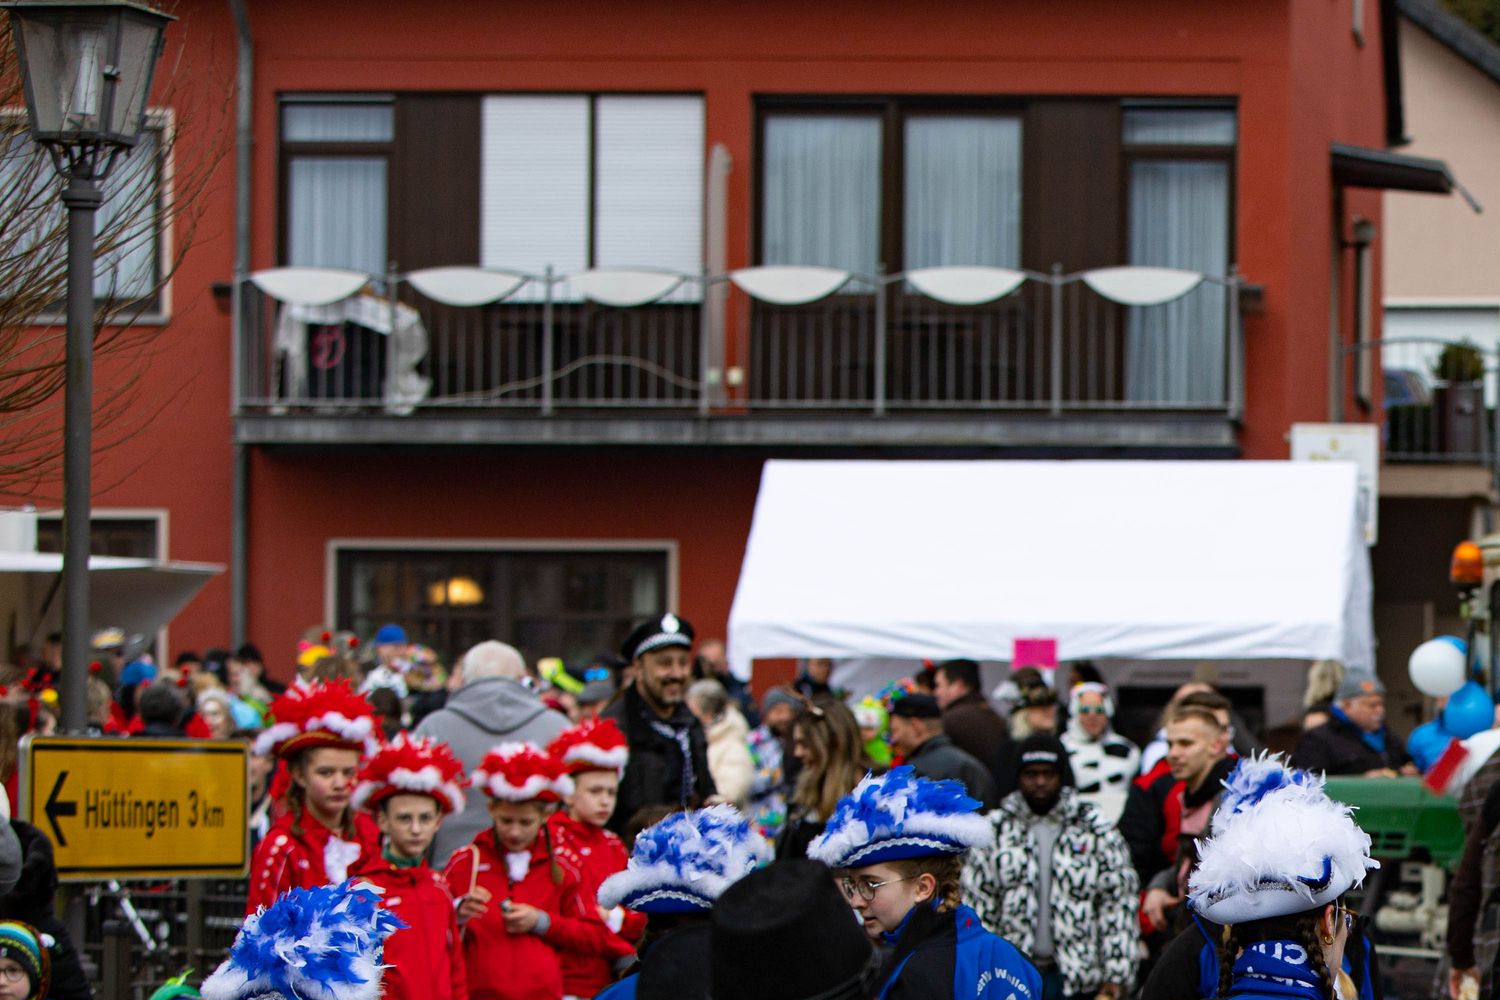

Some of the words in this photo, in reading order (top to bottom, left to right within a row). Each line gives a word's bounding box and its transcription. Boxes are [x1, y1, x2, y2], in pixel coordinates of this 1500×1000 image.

[84, 789, 180, 838] Hüttingen
[188, 790, 199, 828] 3
[203, 803, 224, 828] km
